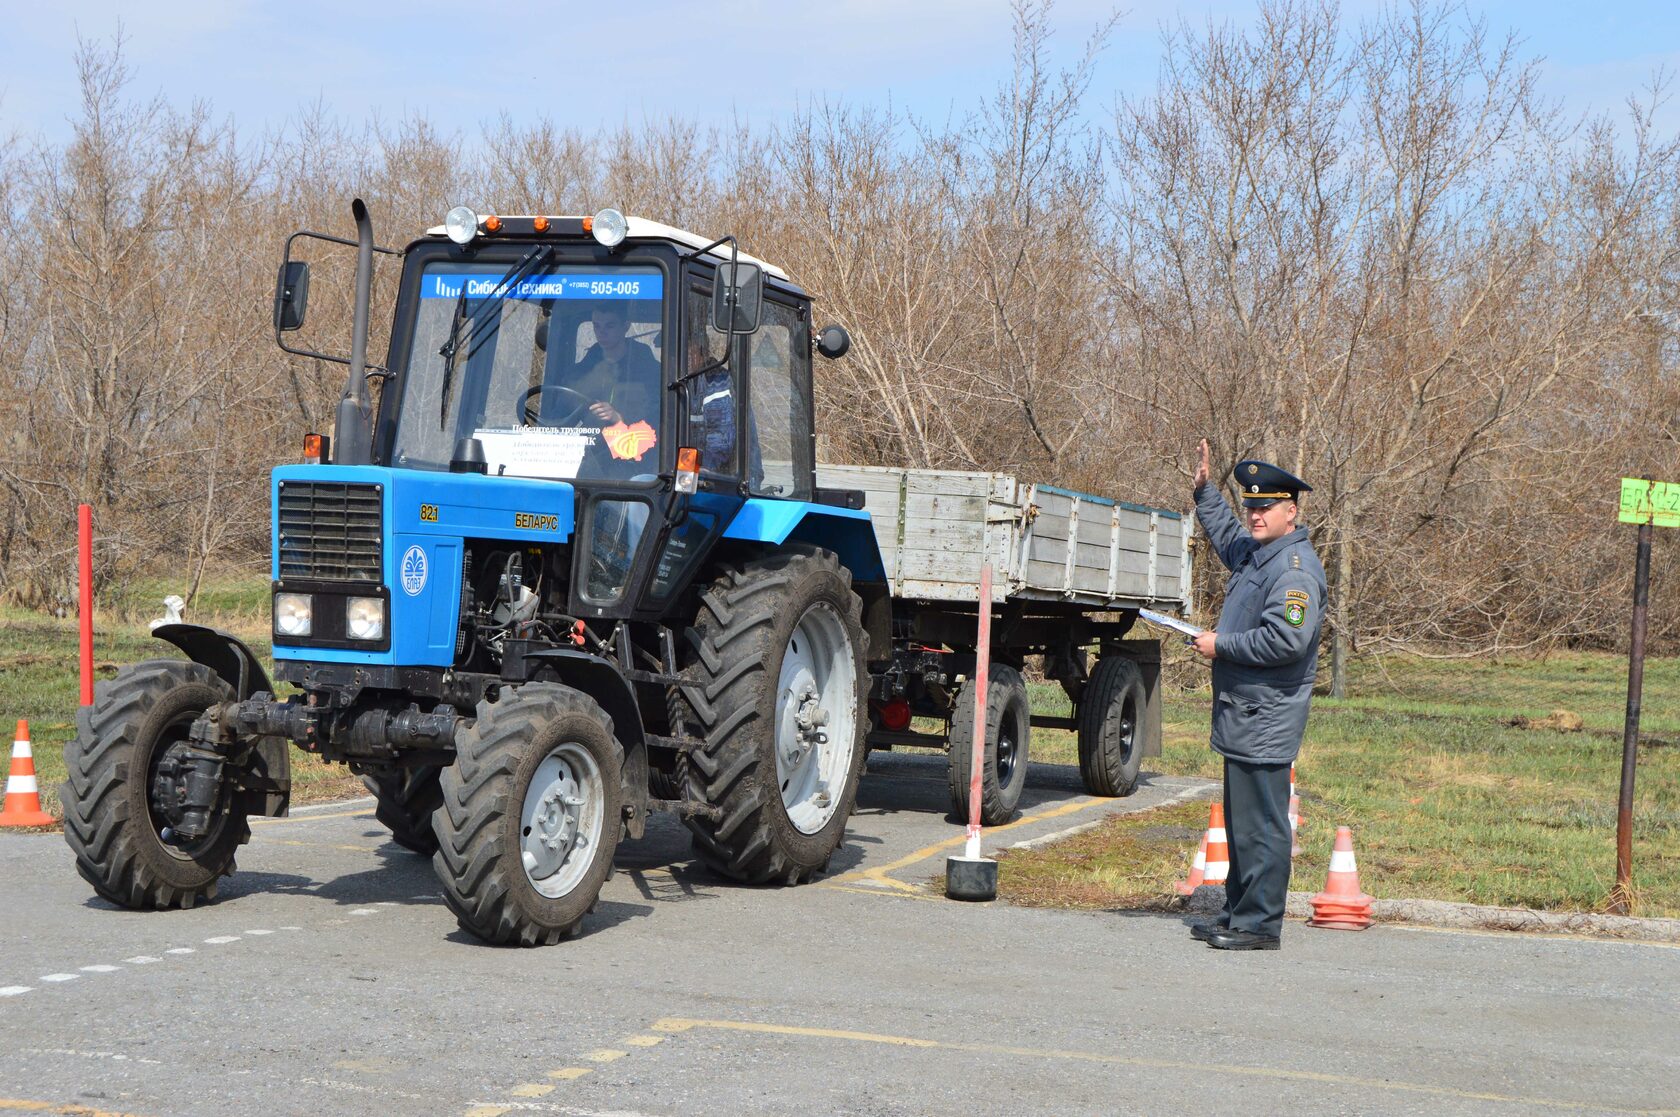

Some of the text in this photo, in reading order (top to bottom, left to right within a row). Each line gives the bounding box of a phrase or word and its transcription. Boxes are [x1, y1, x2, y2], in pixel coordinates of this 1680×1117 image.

[590, 281, 640, 295] 505-005
[511, 424, 601, 438] Победитель трудового
[420, 504, 439, 522] 82.1
[515, 513, 559, 531] БЕЛАРУС
